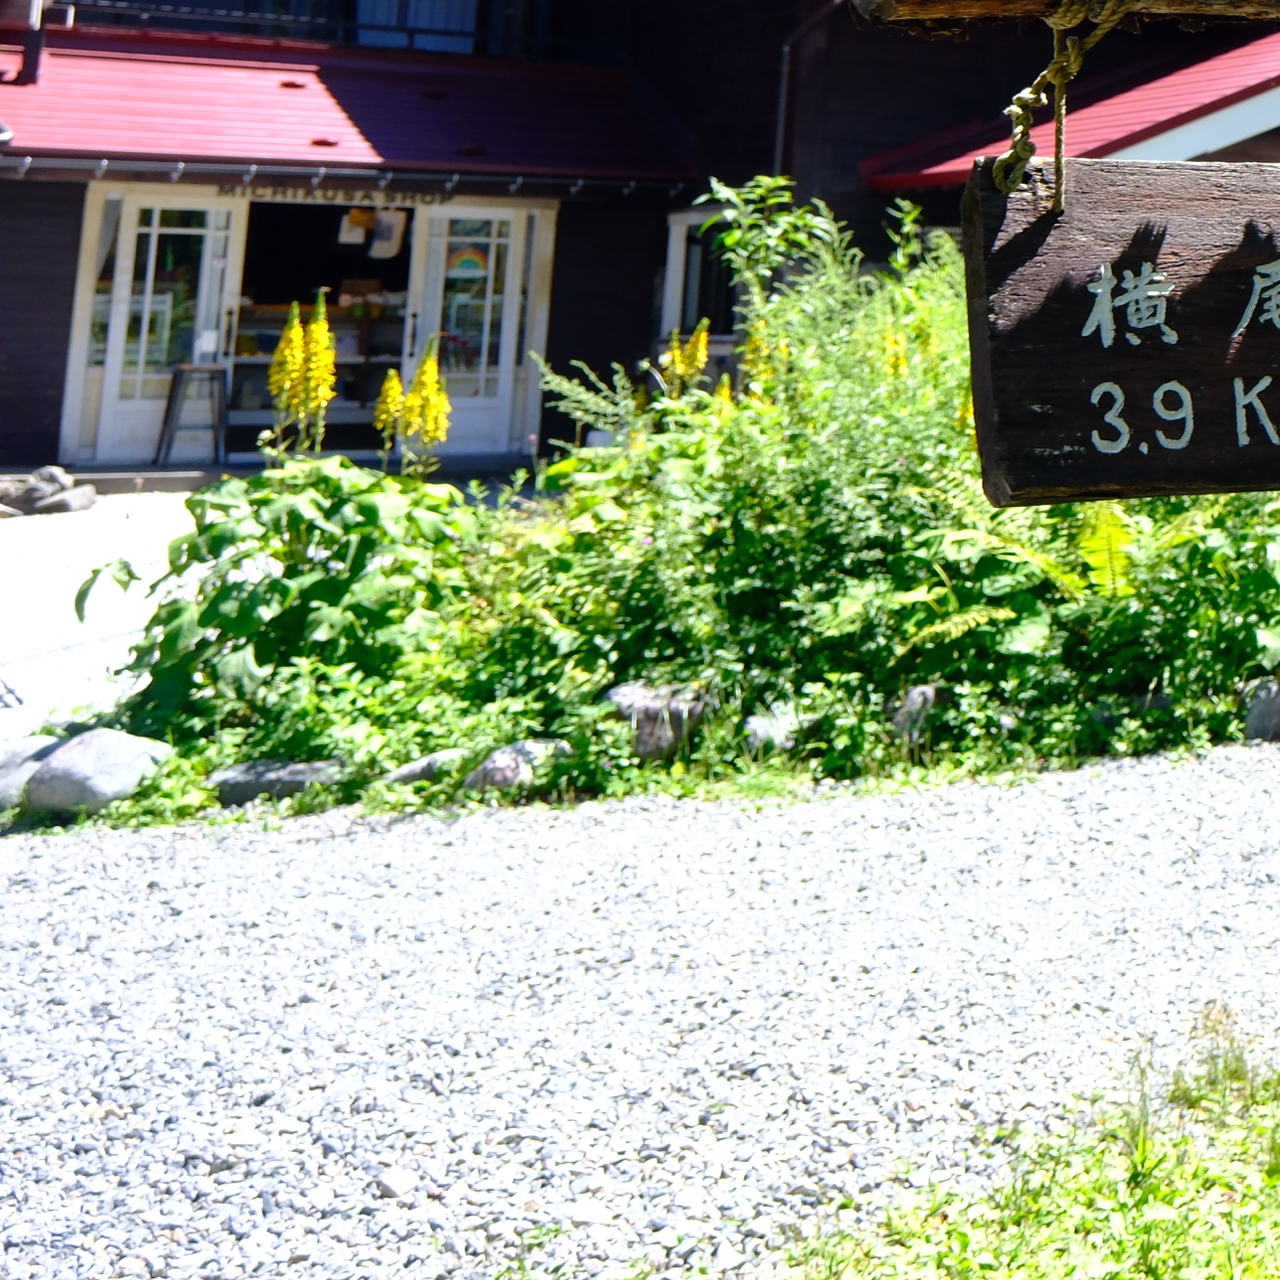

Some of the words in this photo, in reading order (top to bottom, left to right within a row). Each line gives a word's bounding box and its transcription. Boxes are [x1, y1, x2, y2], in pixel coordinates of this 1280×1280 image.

[217, 185, 379, 204] MICHIKUSA
[382, 191, 454, 206] SHOP
[1090, 380, 1194, 454] 3.9
